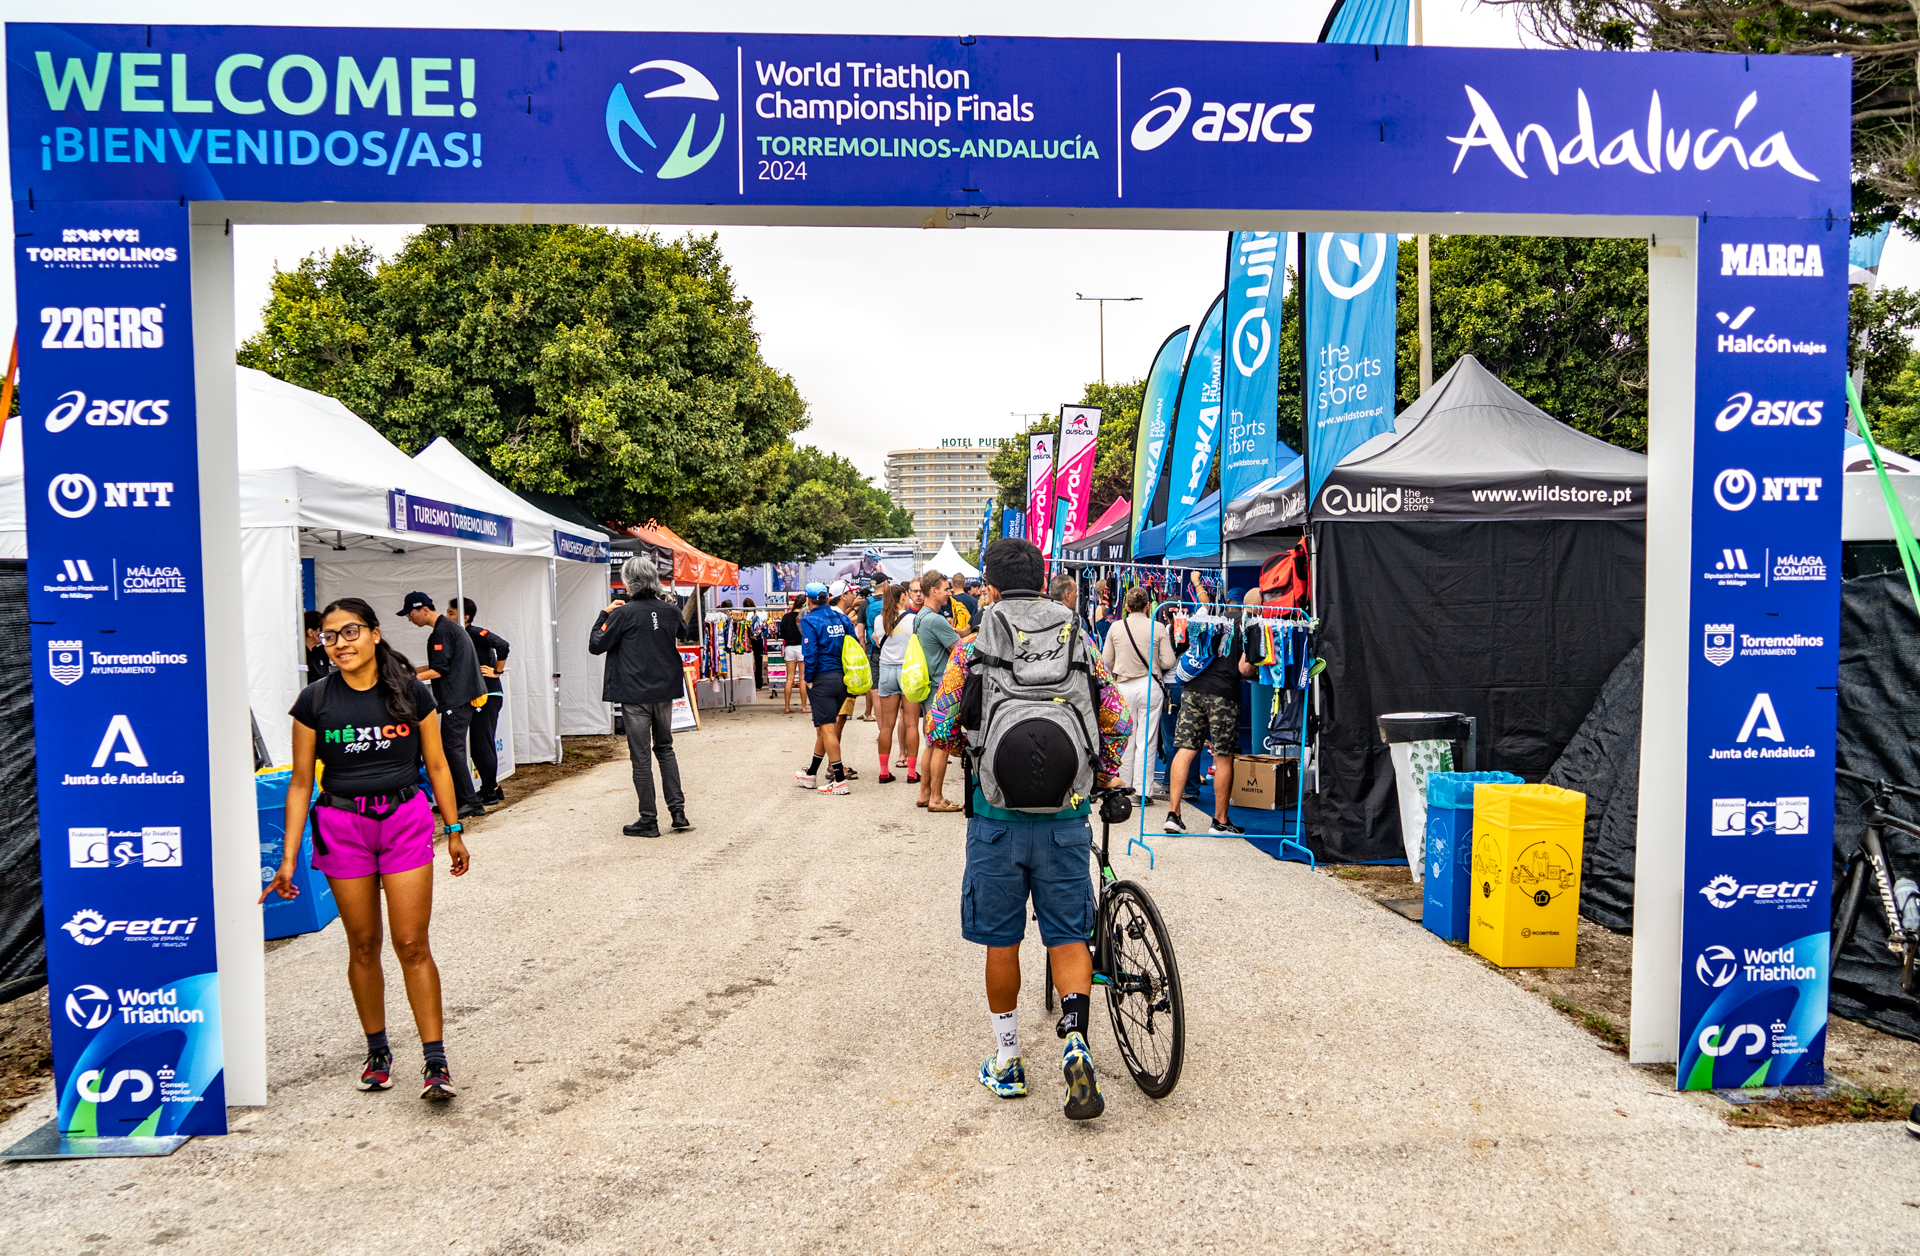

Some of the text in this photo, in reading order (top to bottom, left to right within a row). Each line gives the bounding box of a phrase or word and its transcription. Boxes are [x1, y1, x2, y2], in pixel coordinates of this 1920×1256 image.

[755, 60, 970, 89] World Triathlon
[35, 51, 477, 118] WELCOME!
[755, 92, 1034, 127] Championship Finals
[1446, 84, 1821, 182] Andalucía
[41, 126, 483, 176] ¡BIENVENIDOS/AS!
[757, 134, 1100, 160] TORREMOLINOS-ANDALUCÍA
[758, 160, 808, 181] 2024
[26, 247, 177, 262] TORREMOLINOS
[1720, 243, 1824, 277] MARCA
[40, 306, 164, 349] 226ERS
[1717, 333, 1827, 355] Halcón viajes
[1320, 343, 1350, 367] the
[1209, 355, 1221, 403] HUMAN
[1319, 356, 1381, 393] sports
[1201, 382, 1211, 403] FLY
[1318, 382, 1367, 410] store
[1317, 406, 1384, 429] www.wildstore.pt
[942, 438, 973, 447] HOTEL
[103, 482, 174, 507] NTT
[1404, 489, 1420, 498] the
[1471, 486, 1632, 506] www.wildstore.pt
[1762, 477, 1822, 501] NTT
[1404, 496, 1435, 505] sports
[1404, 503, 1429, 512] store
[413, 505, 450, 528] TURISMO
[450, 512, 498, 537] TORREMOLINOS
[560, 538, 583, 554] FINISHER
[1777, 555, 1823, 566] MÁLAGA
[126, 565, 181, 577] MÁLAGA
[1773, 565, 1826, 577] COMPITE
[123, 577, 186, 588] COMPITE
[1740, 634, 1824, 647] Torremolinos
[90, 651, 188, 665] Torremolinos
[1740, 648, 1797, 656] AYUNTAMIENTO
[90, 666, 156, 674] AYUNTAMIENTO
[325, 723, 411, 744] MÉXICO
[344, 739, 391, 754] SIGO YO
[1709, 745, 1816, 759] Junta de Andalucía
[61, 771, 185, 785] Junta de Andalucía
[1743, 947, 1794, 965] World
[1743, 965, 1816, 982] Triathlon
[117, 988, 177, 1006] World
[118, 1006, 204, 1024] Triathlon
[1771, 1034, 1798, 1042] Consejo
[1771, 1041, 1799, 1049] Superior
[160, 1081, 189, 1090] Consejo
[160, 1088, 192, 1097] Superior
[171, 1096, 204, 1104] Deportes
